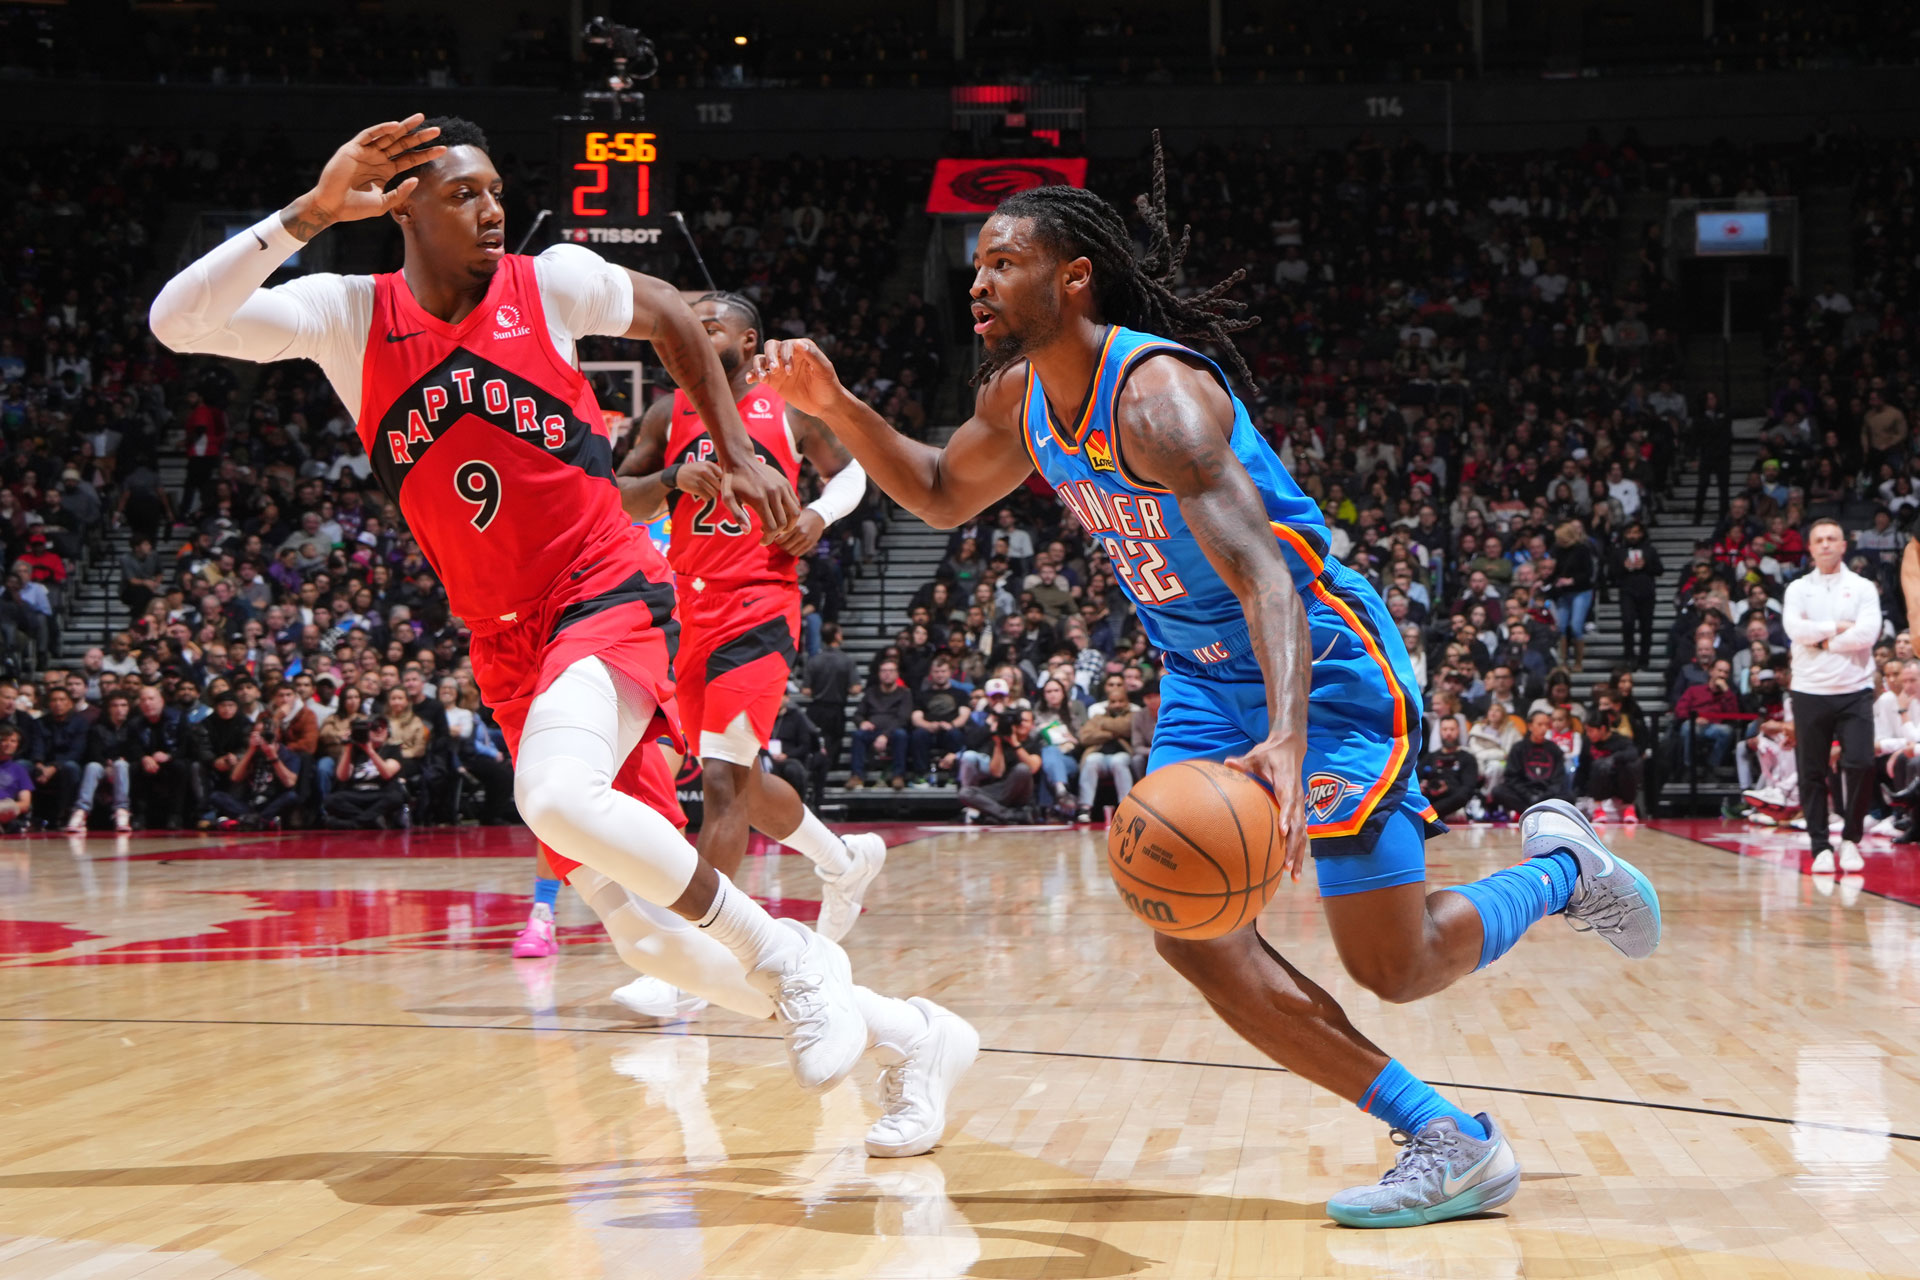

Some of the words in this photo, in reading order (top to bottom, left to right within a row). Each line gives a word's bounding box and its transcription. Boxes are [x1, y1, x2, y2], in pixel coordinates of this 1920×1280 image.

[696, 103, 733, 123] 113
[1365, 97, 1403, 117] 114
[585, 132, 657, 162] 6:56
[572, 163, 650, 216] 21
[588, 228, 662, 243] TISSOT
[493, 330, 511, 340] Sun
[512, 325, 531, 337] Life
[387, 368, 566, 464] RAPTORS
[454, 459, 502, 533] 9
[1103, 538, 1189, 606] 22
[1192, 641, 1230, 664] OKC
[1308, 783, 1336, 809] OKC
